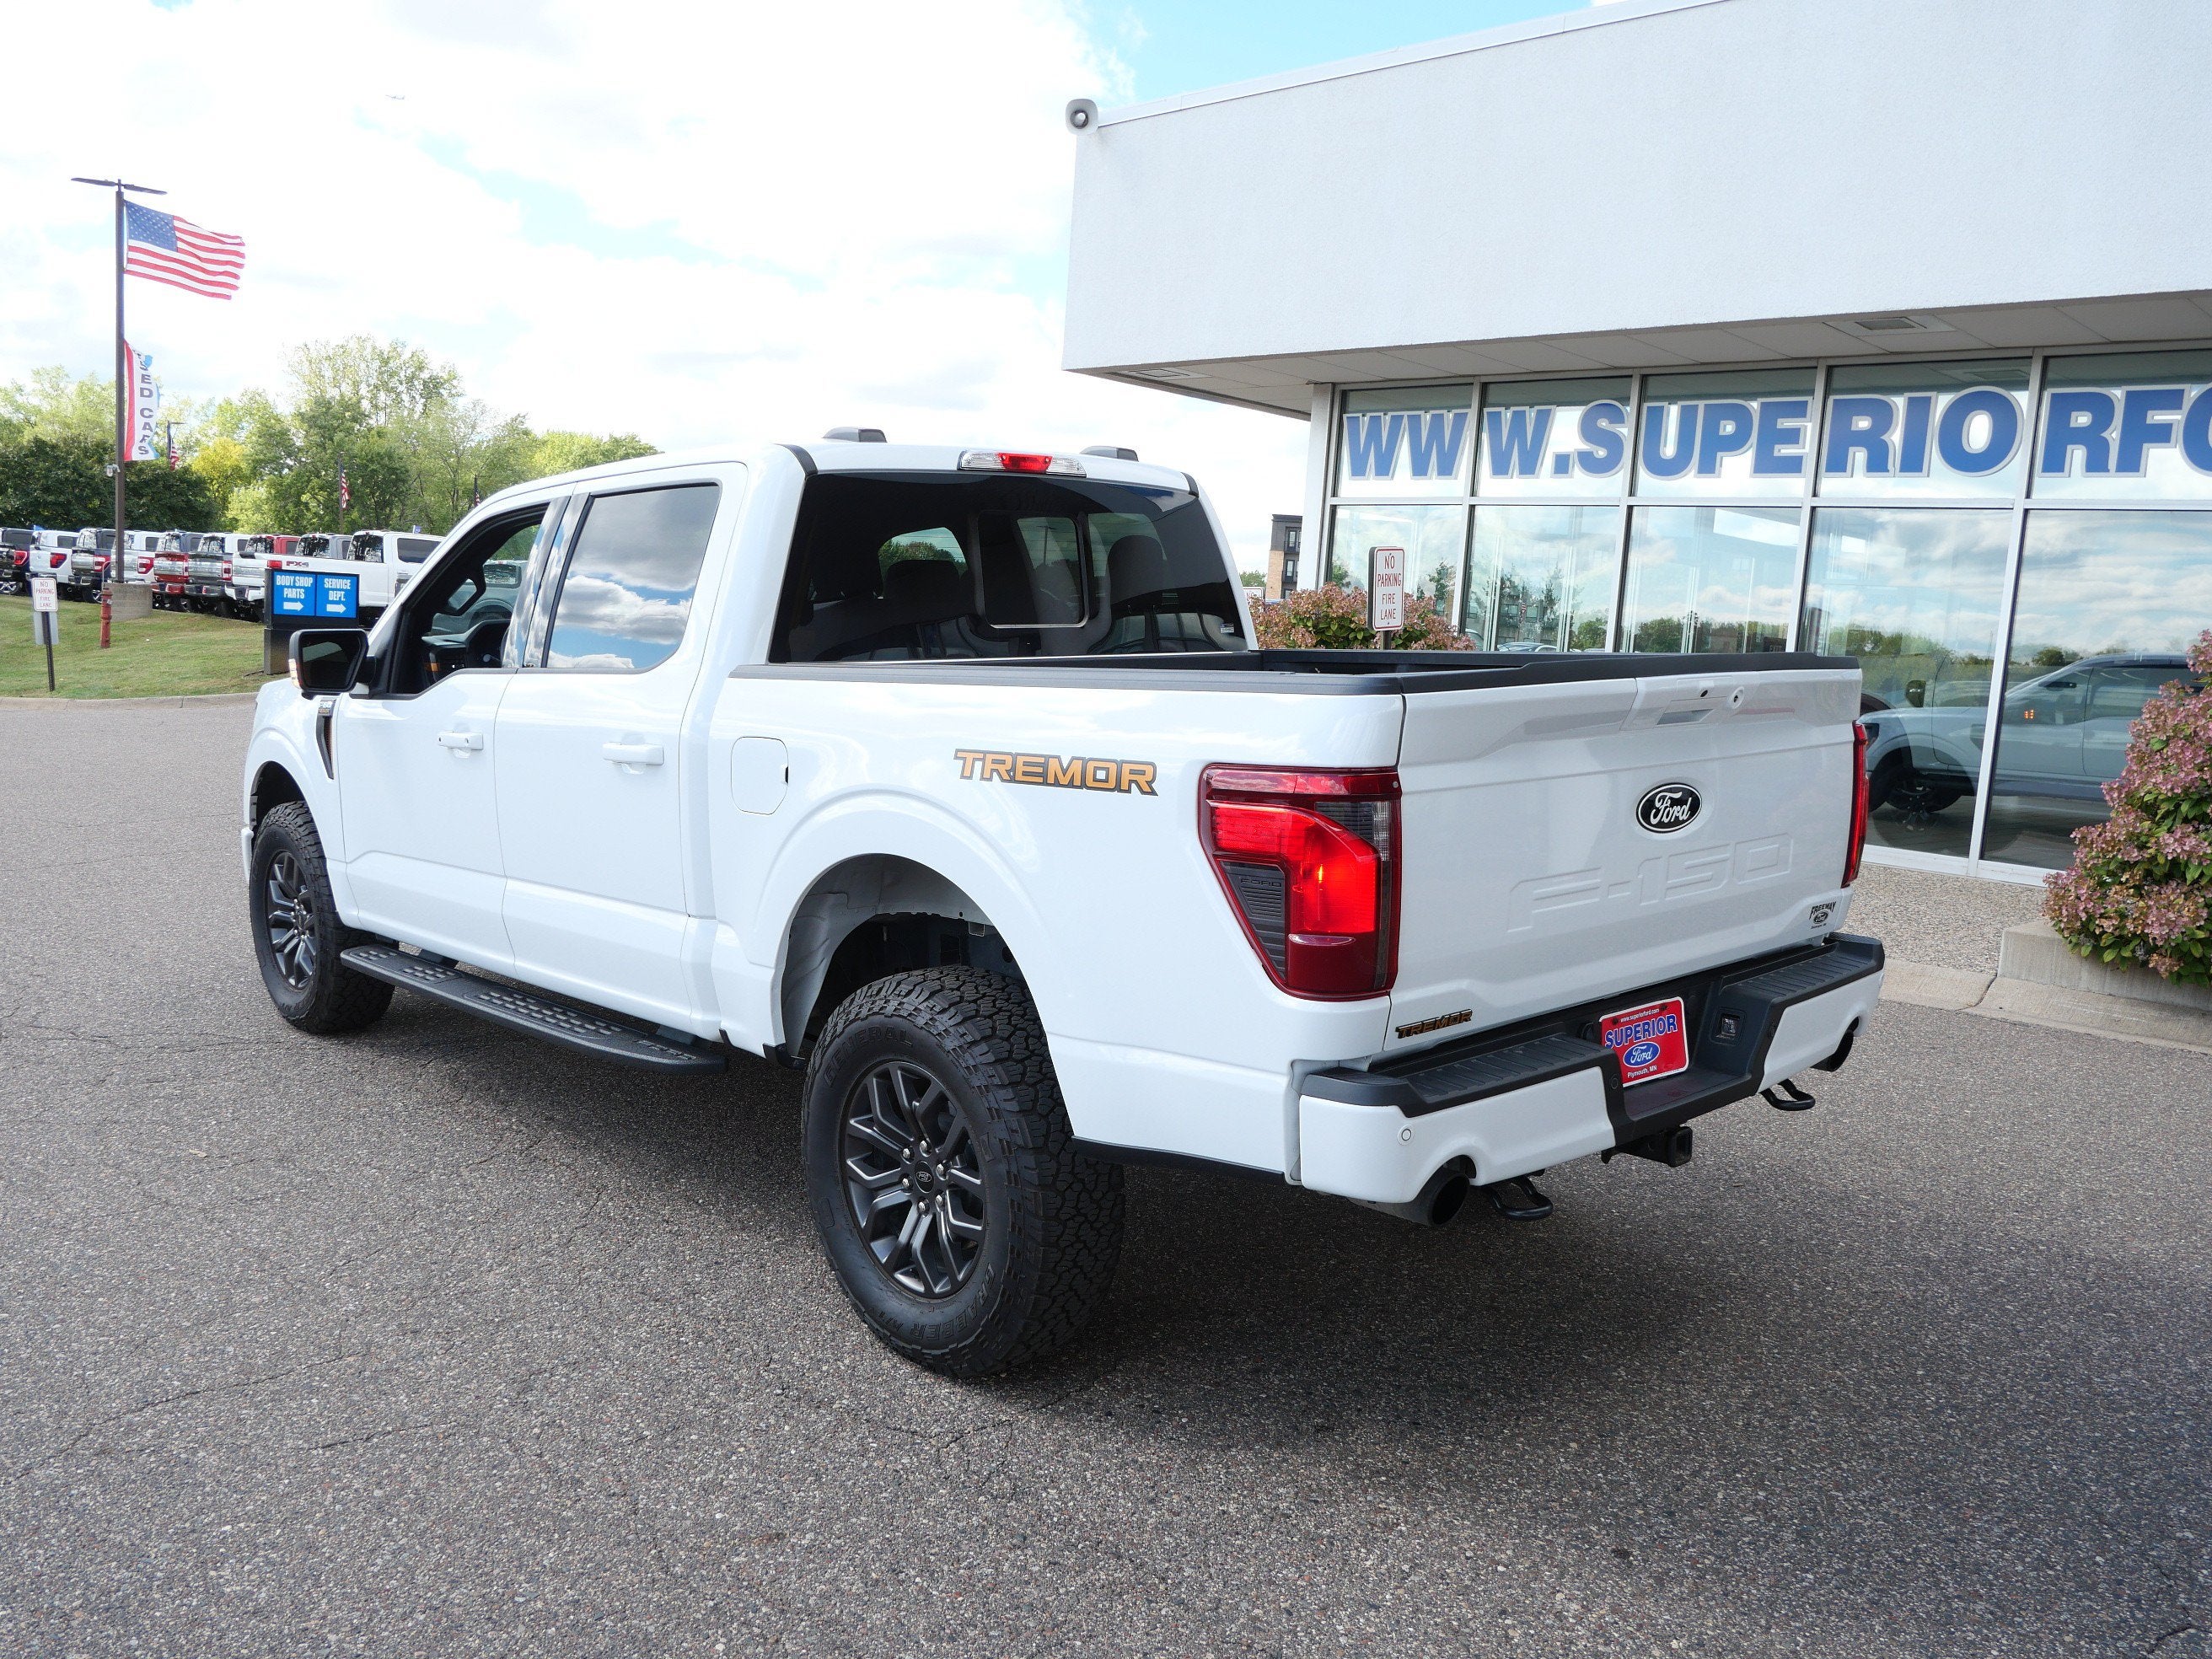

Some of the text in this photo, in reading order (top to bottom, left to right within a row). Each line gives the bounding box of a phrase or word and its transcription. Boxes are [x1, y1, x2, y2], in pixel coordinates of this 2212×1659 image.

[1384, 556, 1395, 569] NO
[276, 575, 314, 588] BODY SHOP
[324, 577, 352, 590] SERVICE
[1377, 573, 1402, 588] PARKING
[283, 588, 305, 599] PARTS
[328, 591, 346, 601] DEPT.
[1382, 593, 1396, 605] FIRE
[1380, 608, 1397, 620] LANE
[953, 748, 1159, 797] TREMOR
[1650, 791, 1693, 825] Ford
[1240, 878, 1282, 889] FORD
[1506, 832, 1794, 933] F-150
[1619, 1007, 1660, 1023] www.superiorford.com
[1394, 1007, 1474, 1039] TREMOR
[1604, 1013, 1678, 1050] SUPERIOR
[823, 1025, 914, 1089] GENERAL
[1629, 1044, 1654, 1064] Ford
[1627, 1064, 1658, 1079] Plymouth, MN
[910, 1263, 996, 1340] GRABBER
